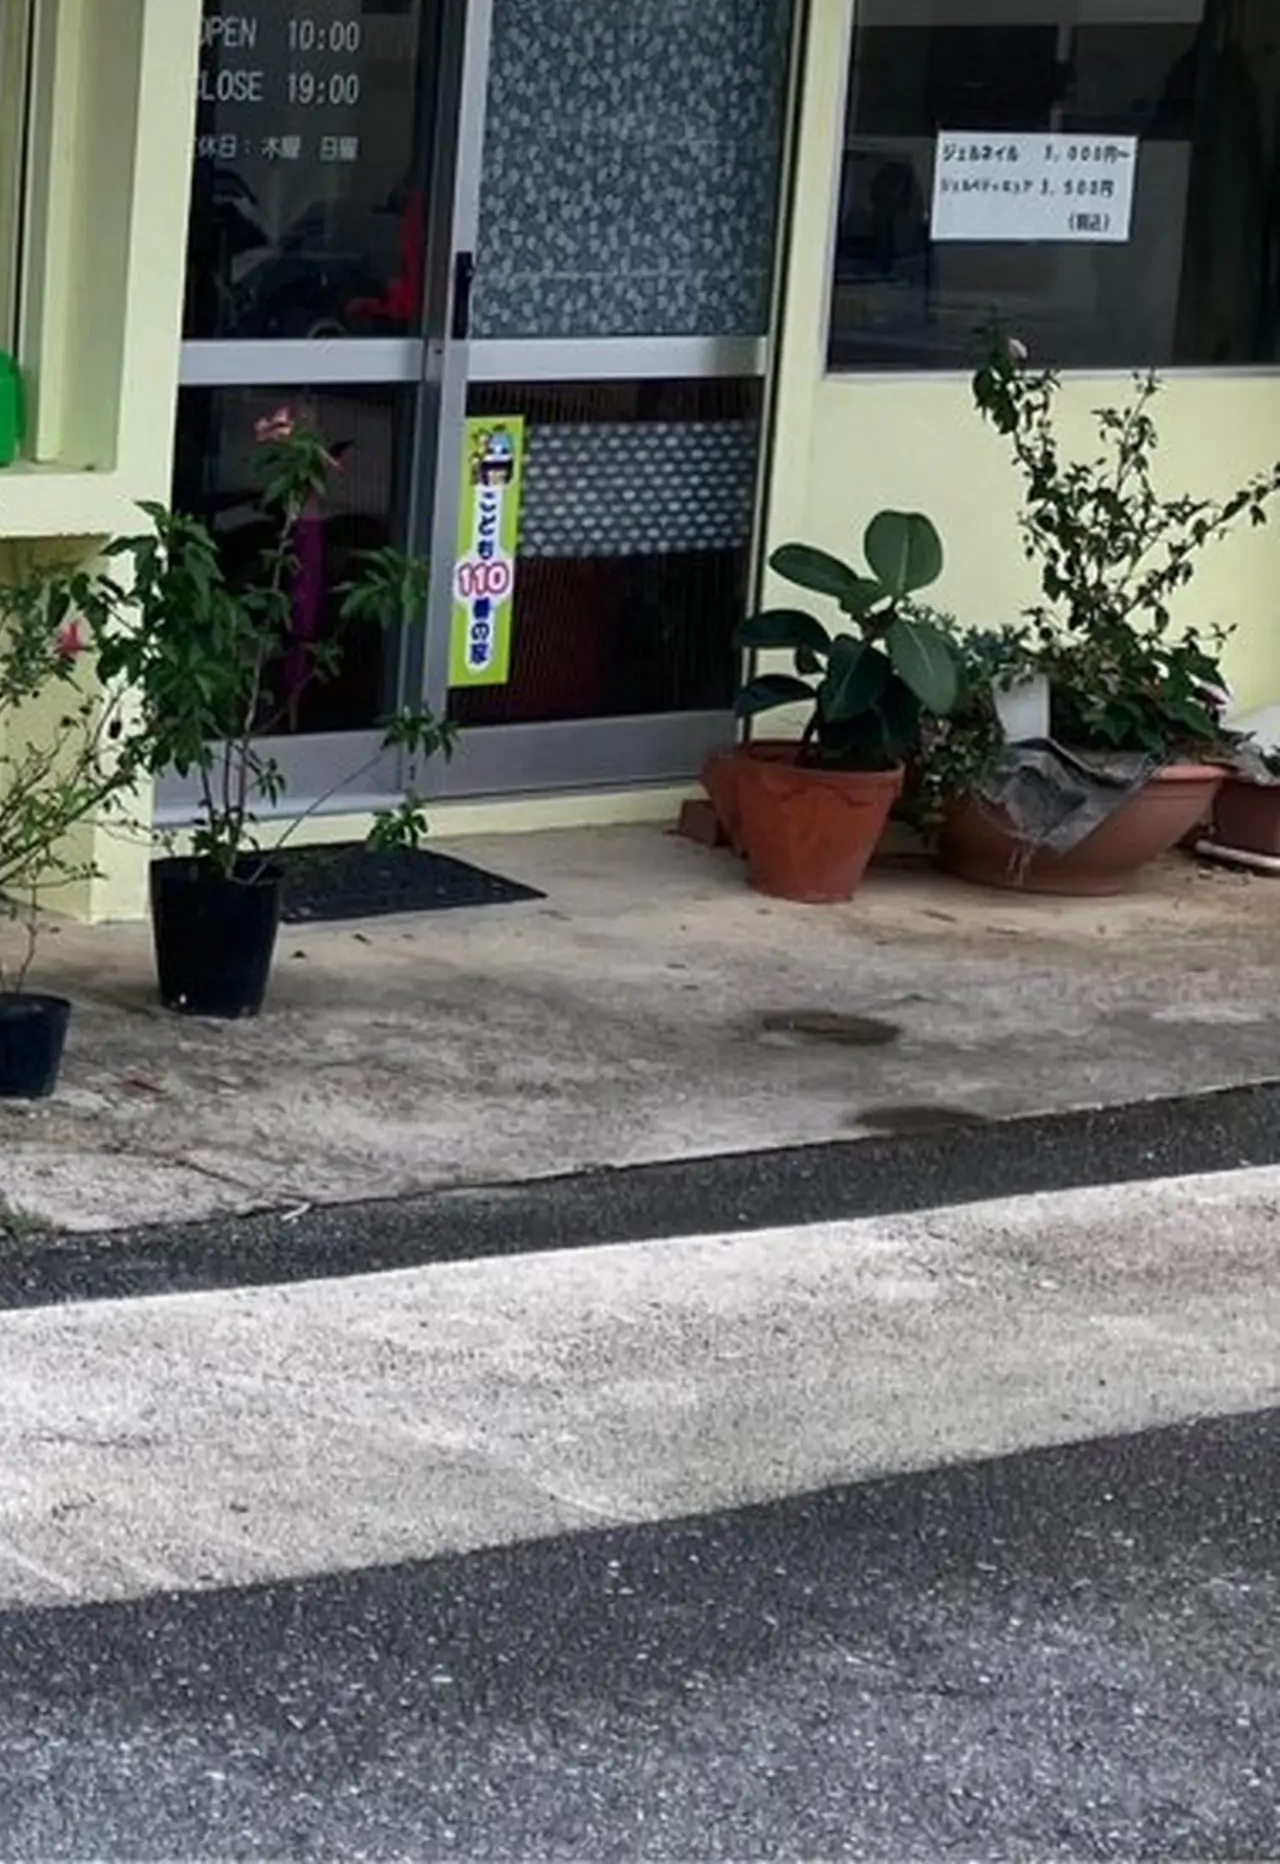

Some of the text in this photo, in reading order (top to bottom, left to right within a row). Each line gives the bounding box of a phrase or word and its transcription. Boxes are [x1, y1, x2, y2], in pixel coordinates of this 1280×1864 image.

[288, 20, 360, 52] 10:00
[197, 70, 360, 105] LOSE 19:00
